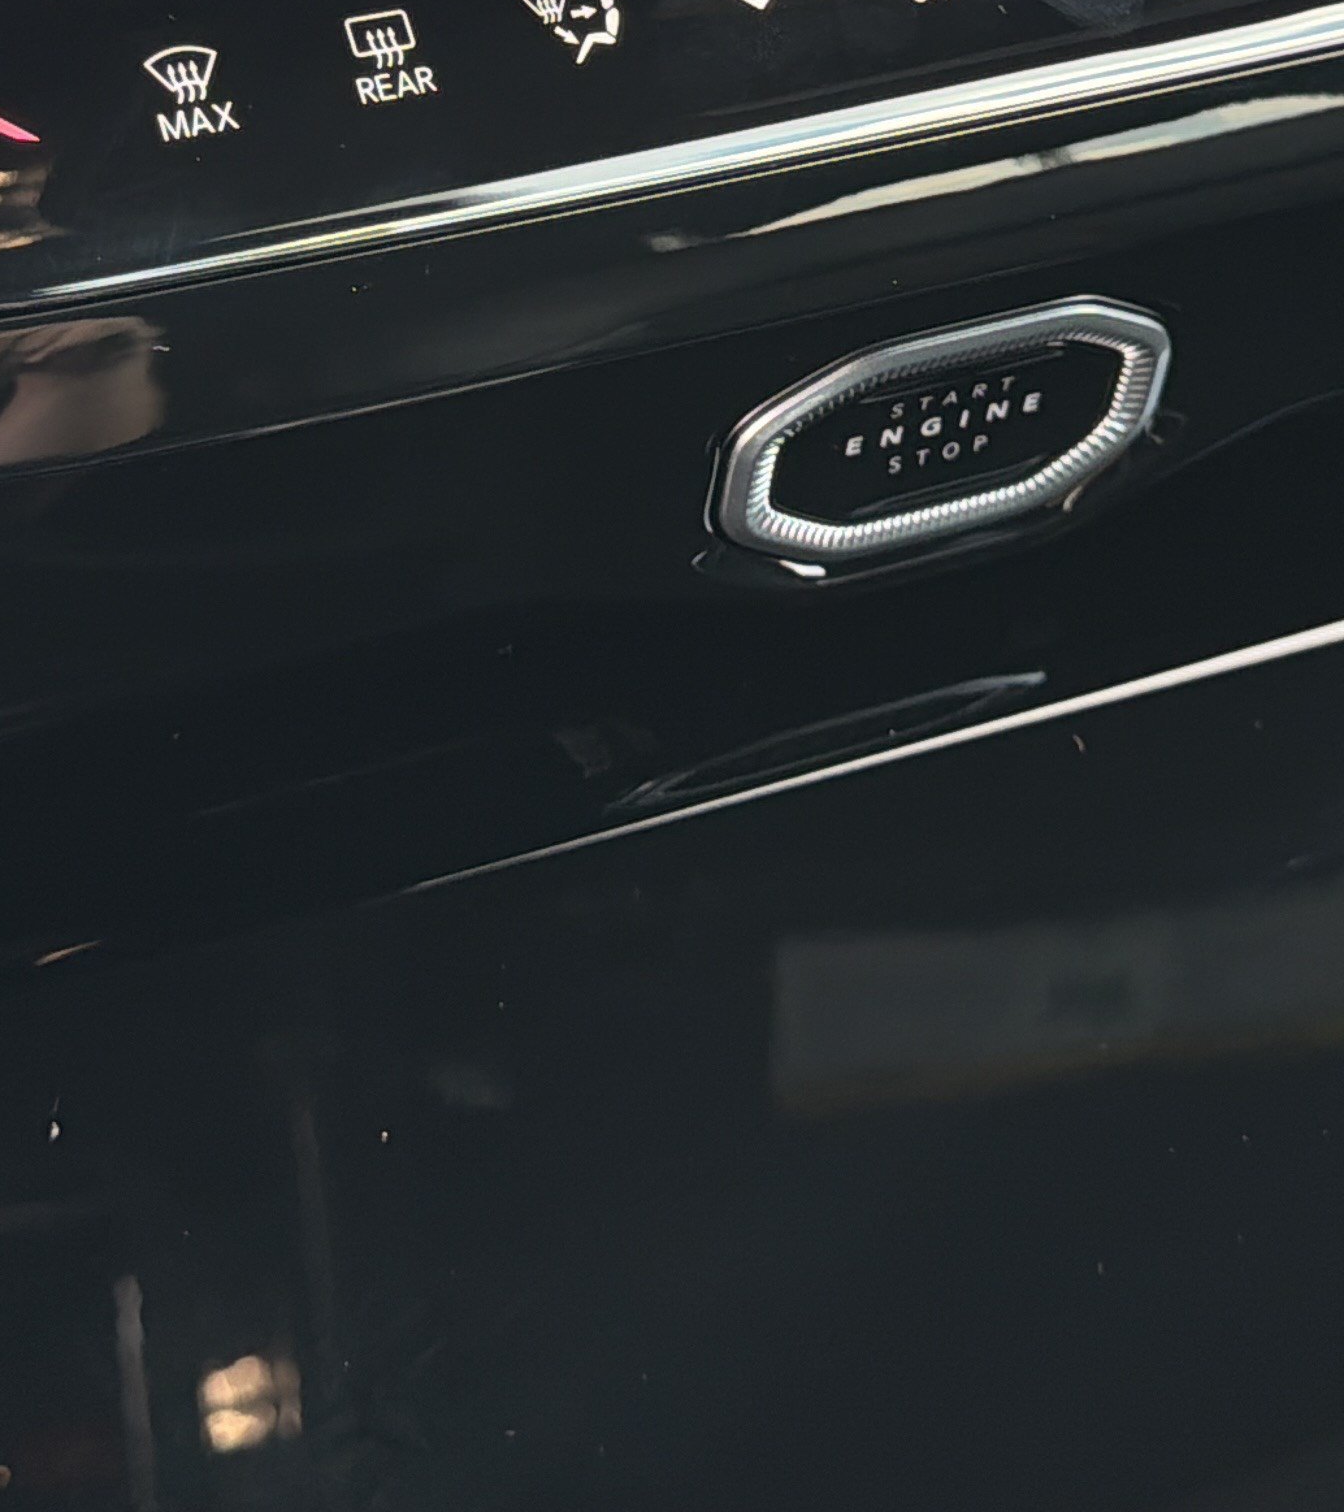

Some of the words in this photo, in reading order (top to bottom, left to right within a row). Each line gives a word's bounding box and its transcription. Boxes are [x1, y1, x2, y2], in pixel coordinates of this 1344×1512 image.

[355, 66, 437, 105] REAR
[156, 102, 240, 143] MAX
[890, 375, 1017, 420] START
[844, 391, 1043, 457] ENGINE
[888, 433, 990, 475] STOP
